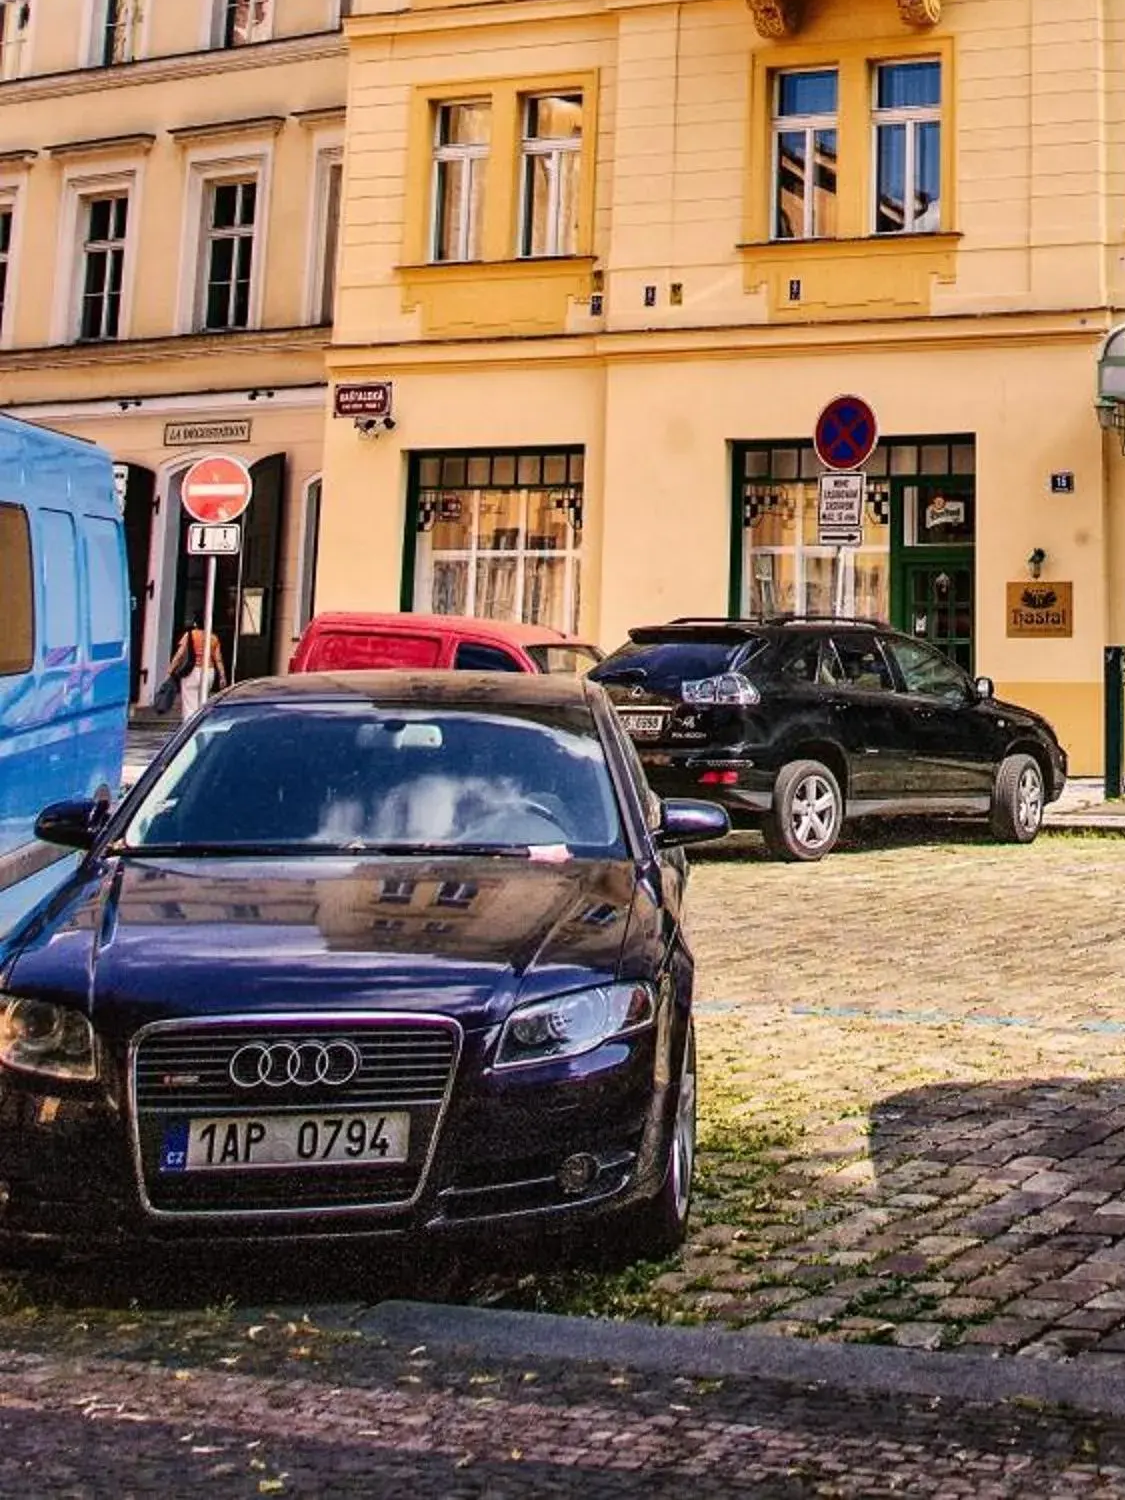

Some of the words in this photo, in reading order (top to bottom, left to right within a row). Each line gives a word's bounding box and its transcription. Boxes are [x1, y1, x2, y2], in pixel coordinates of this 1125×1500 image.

[200, 1122, 267, 1164] 1AP
[296, 1117, 390, 1159] 0794
[166, 1150, 184, 1165] CZ
